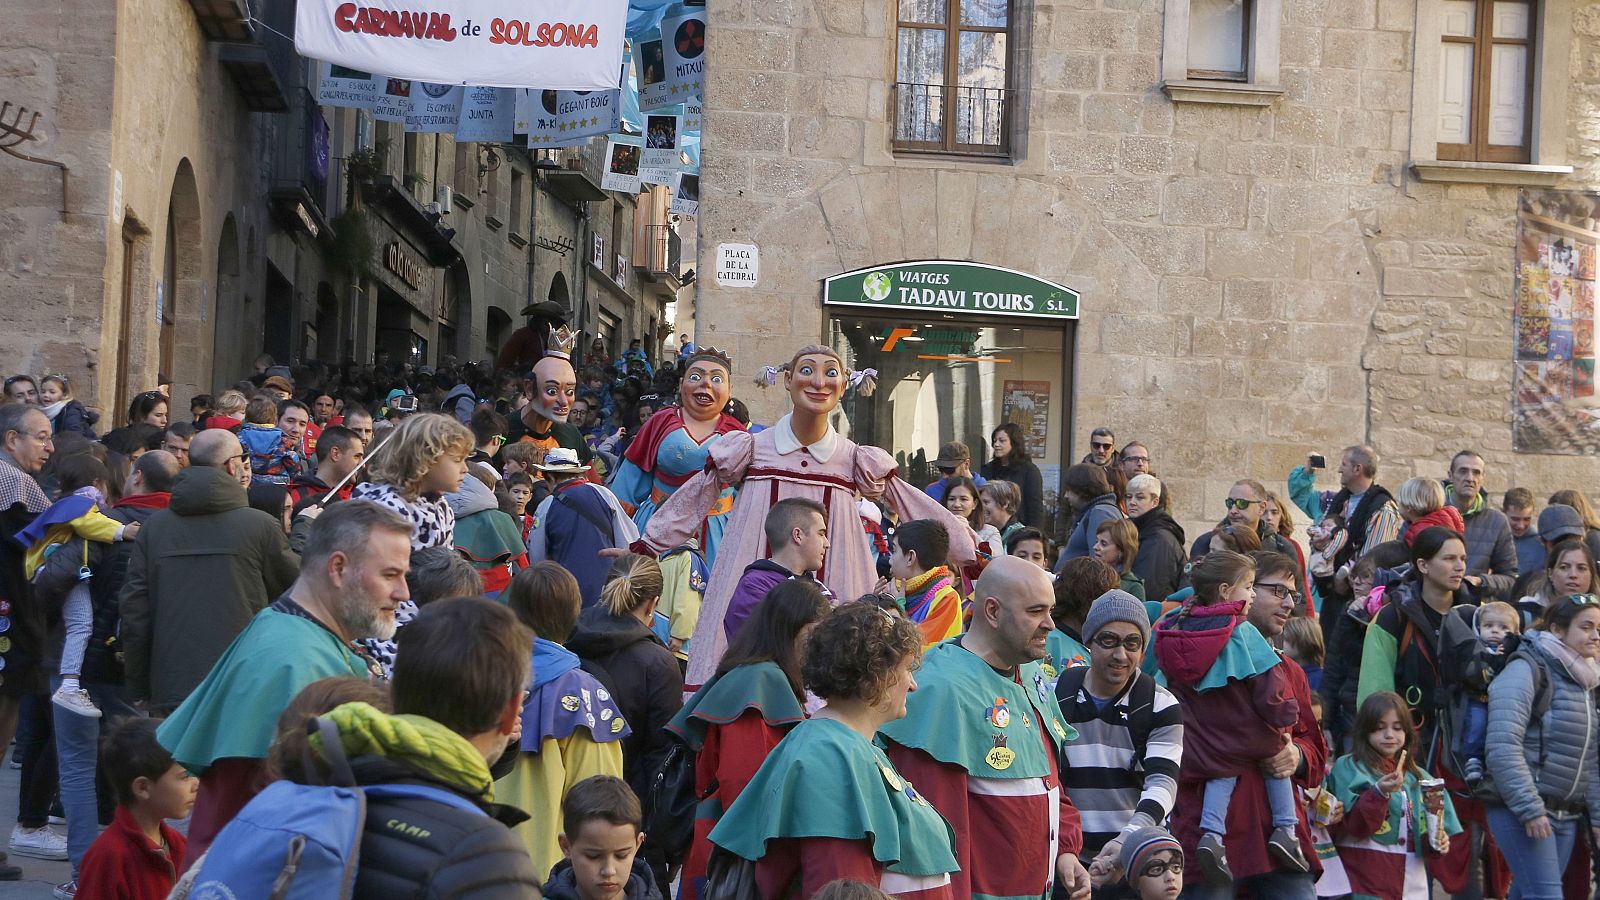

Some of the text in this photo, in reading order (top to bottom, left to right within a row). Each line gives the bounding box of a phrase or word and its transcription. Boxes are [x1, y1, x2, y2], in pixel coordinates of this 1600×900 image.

[335, 3, 599, 48] CARNAVAL de SOLSONA
[559, 95, 609, 115] GEGANT BOIG
[468, 109, 494, 120] JUNTA
[725, 249, 750, 259] PLAÇA
[726, 260, 749, 270] DE LA
[717, 271, 757, 281] CATEDRAL
[899, 271, 950, 285] VIATGES
[898, 287, 1069, 312] TADAVI TOURS S.L.
[386, 819, 432, 838] CAMP
